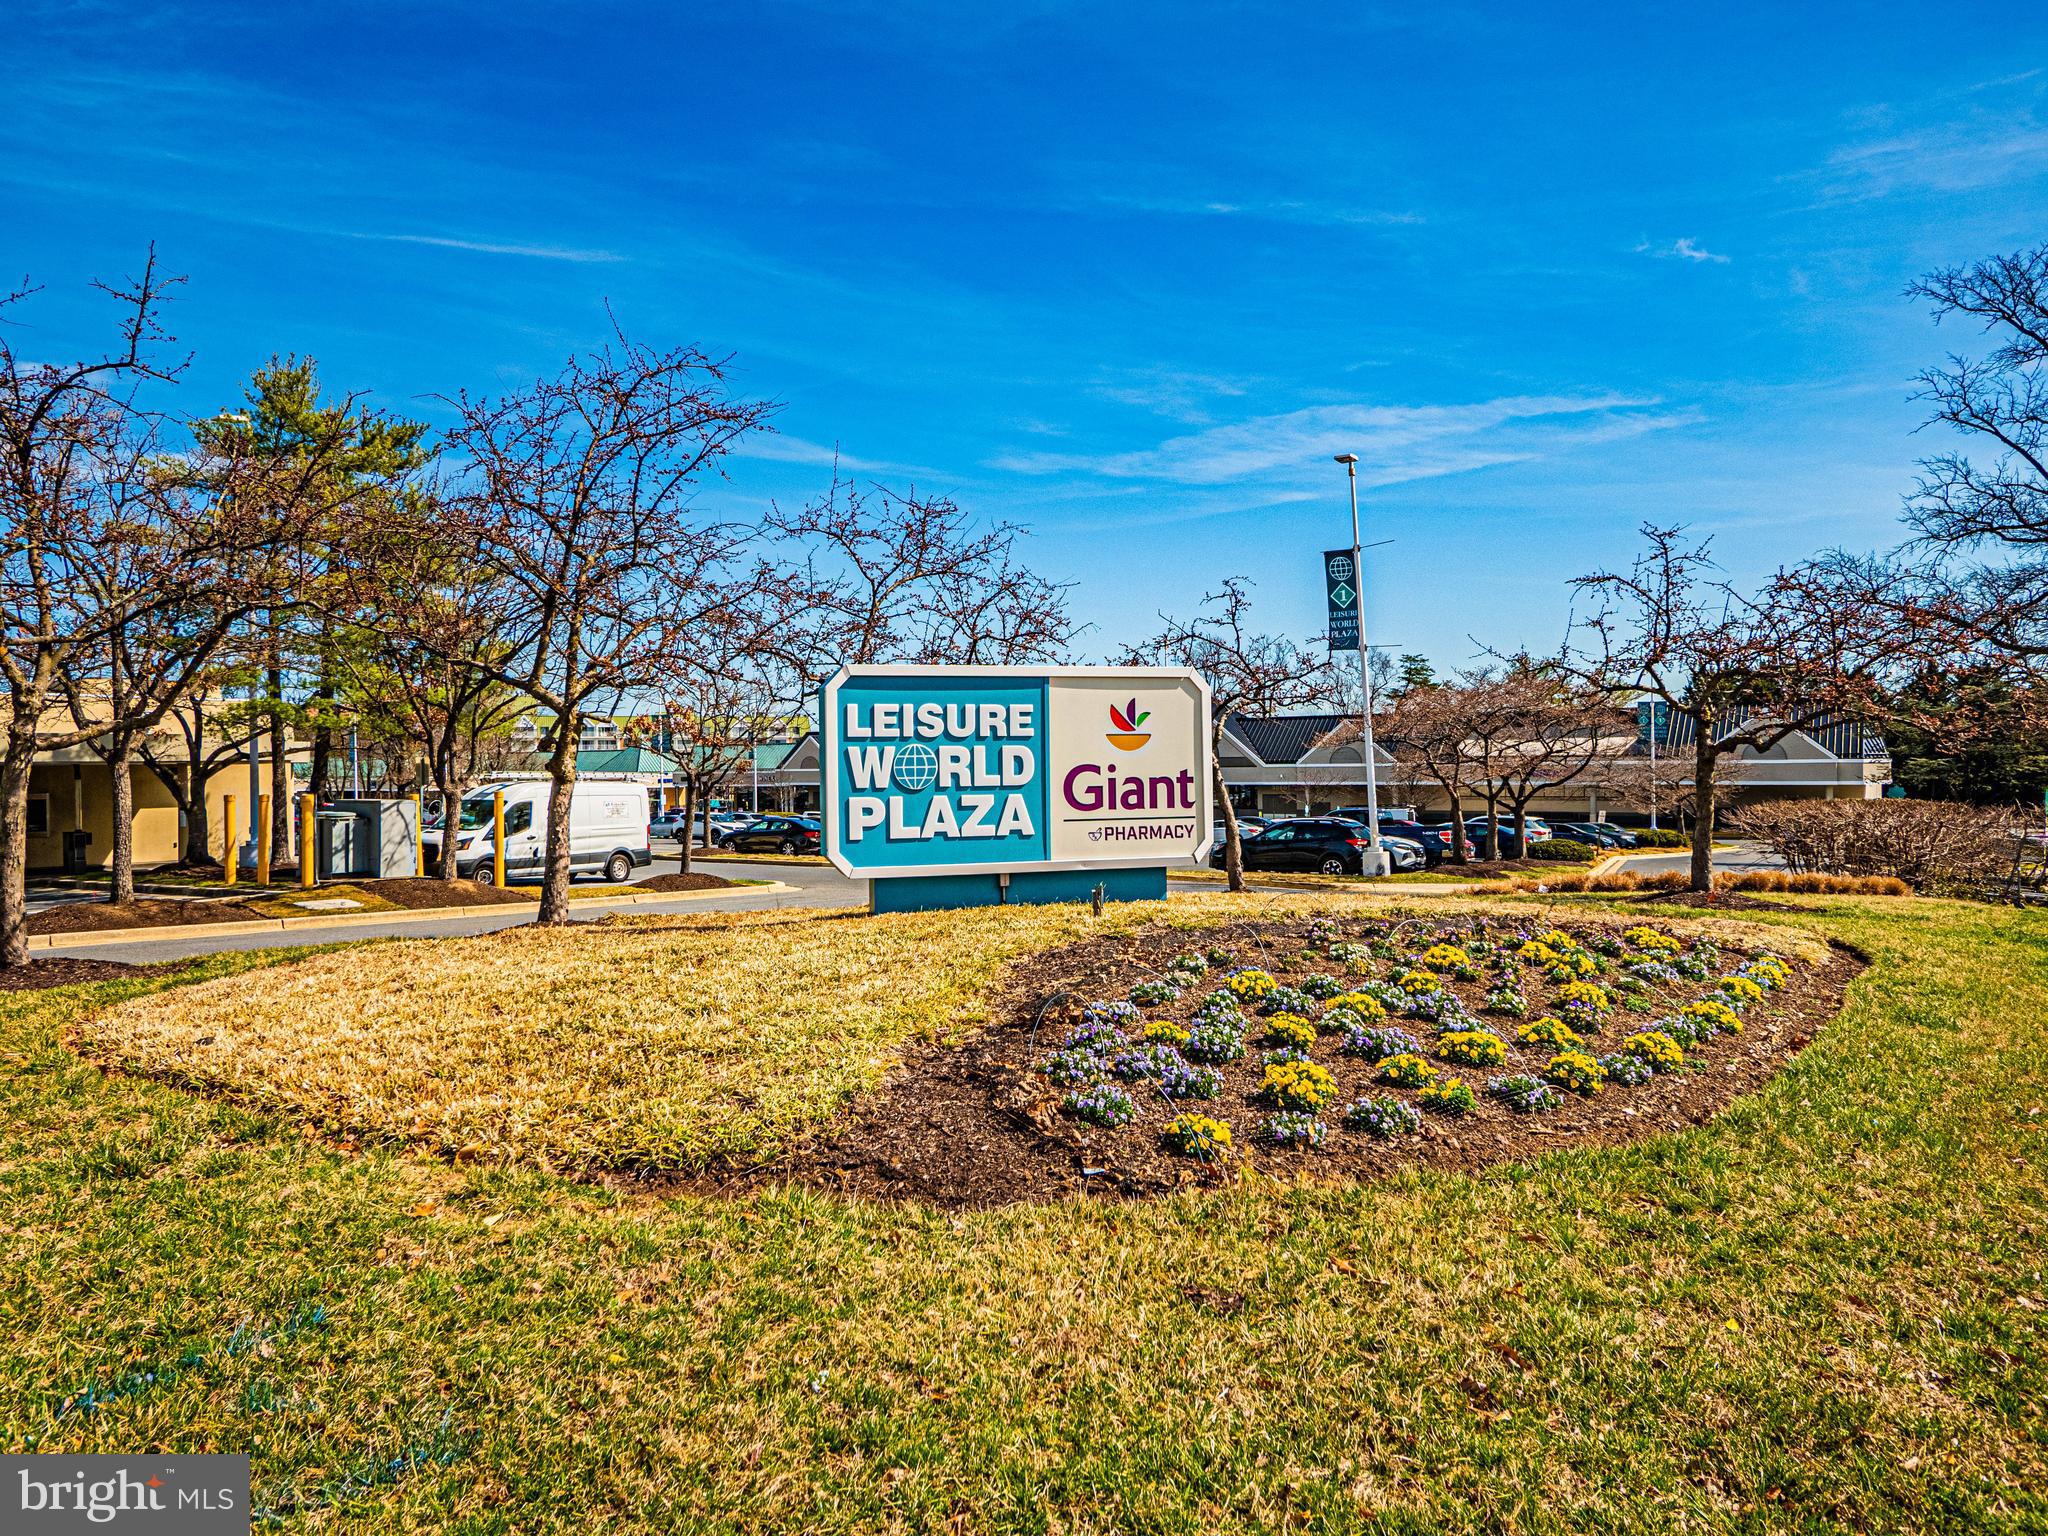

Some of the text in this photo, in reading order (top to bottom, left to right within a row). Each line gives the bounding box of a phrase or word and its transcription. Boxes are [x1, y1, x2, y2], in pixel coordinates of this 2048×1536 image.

[1340, 589, 1347, 601] 1
[1330, 619, 1359, 628] WORLD
[1331, 629, 1359, 638] PLAZA
[846, 703, 1035, 738] LEISURE
[1063, 763, 1195, 812] Giant
[848, 793, 1036, 841] PLAZA
[1104, 825, 1195, 841] PHARMACY
